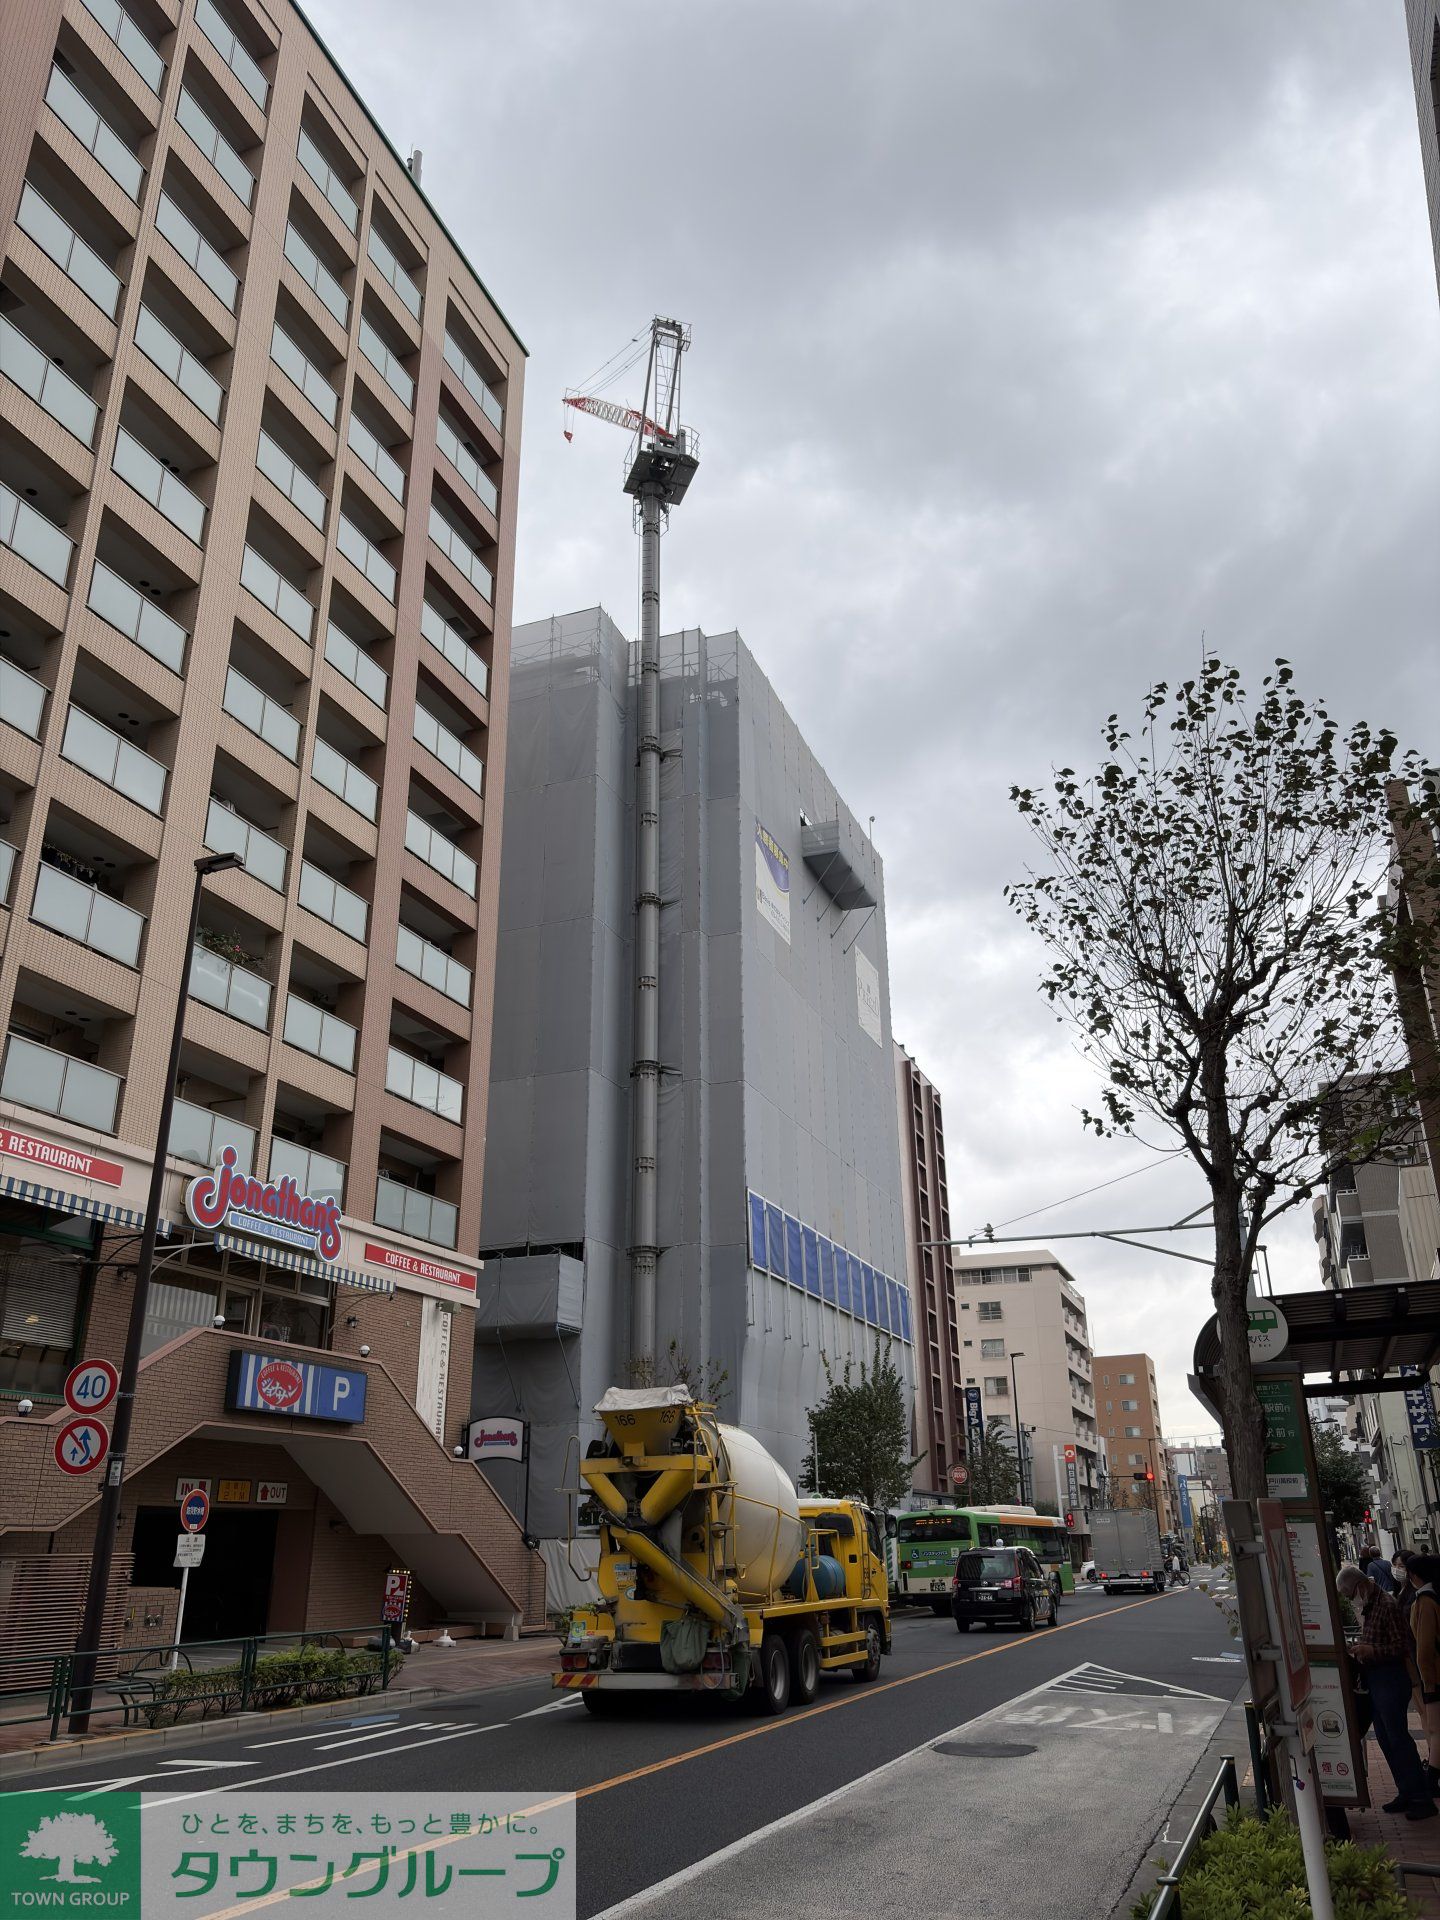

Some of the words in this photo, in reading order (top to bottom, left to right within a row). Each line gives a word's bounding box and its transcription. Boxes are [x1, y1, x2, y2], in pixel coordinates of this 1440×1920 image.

[9, 1135, 93, 1174] RESTAURANT
[238, 1216, 261, 1232] COFFEE
[264, 1225, 269, 1233] &
[271, 1227, 309, 1245] RESTAURANT
[385, 1252, 411, 1270] COFFEE
[412, 1260, 419, 1272] &
[420, 1263, 461, 1284] RESTAURANT
[441, 1313, 449, 1356] COFFEE
[76, 1375, 107, 1399] 40
[332, 1376, 351, 1411] P
[614, 1414, 636, 1426] 166
[659, 1409, 676, 1424] 166
[180, 1483, 194, 1496] IN
[270, 1487, 286, 1499] OUT
